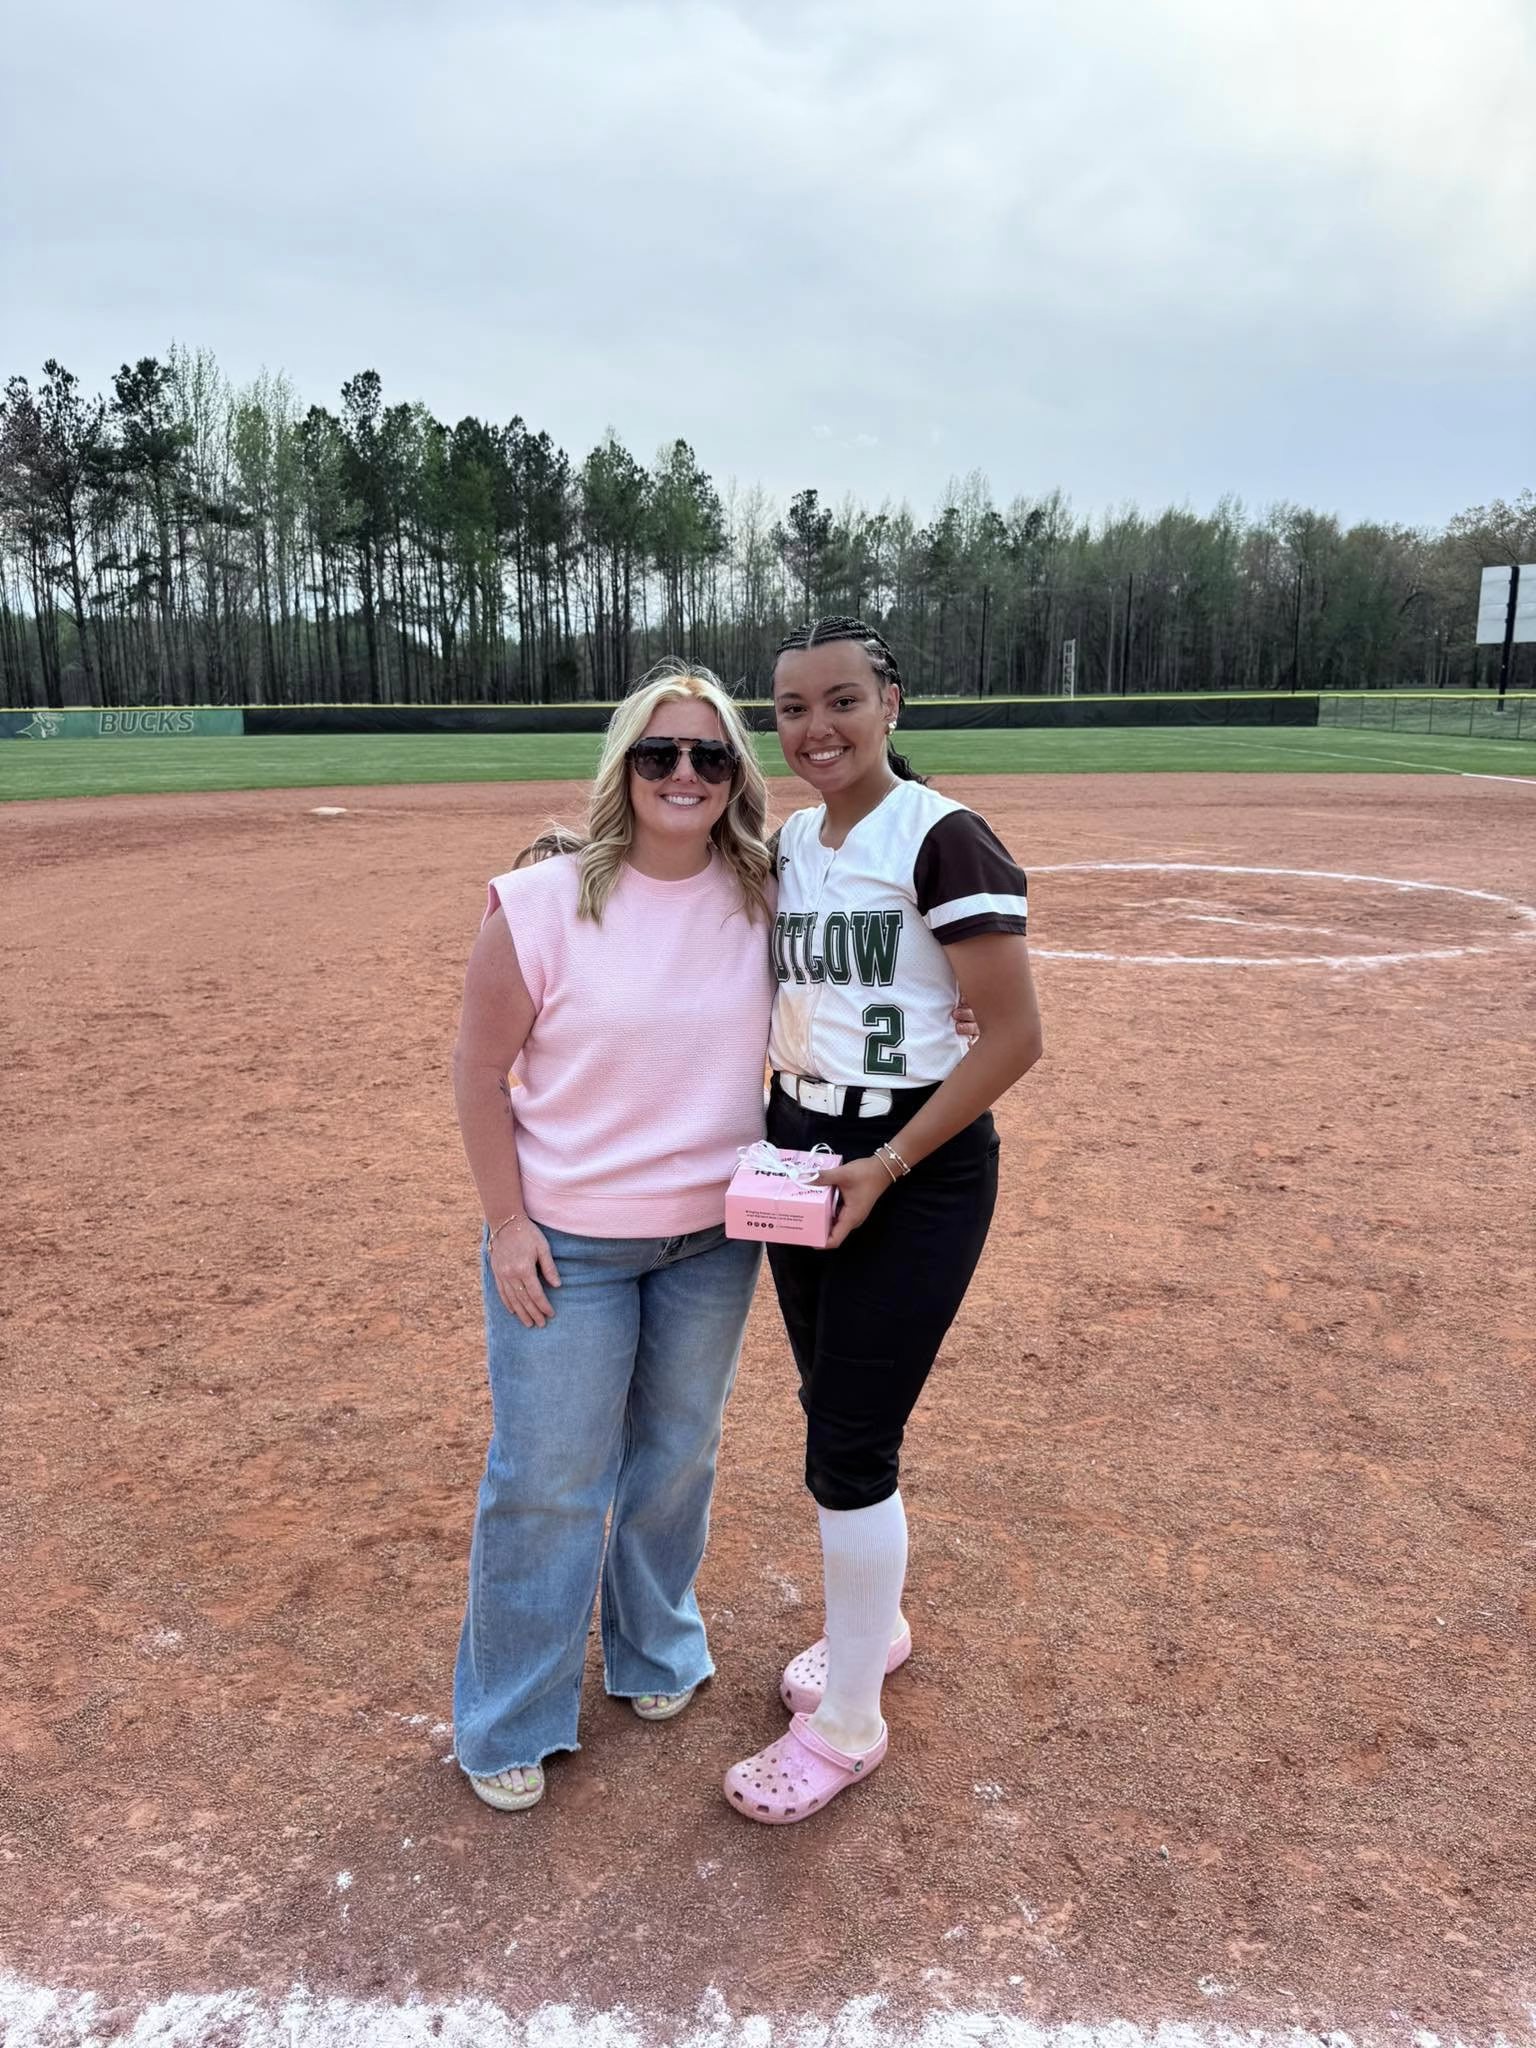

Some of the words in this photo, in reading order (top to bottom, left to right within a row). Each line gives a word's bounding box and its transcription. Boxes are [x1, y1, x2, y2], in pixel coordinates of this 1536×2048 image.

[99, 711, 194, 734] BUCKS
[772, 910, 903, 986] OTLOW
[862, 1003, 906, 1076] 2
